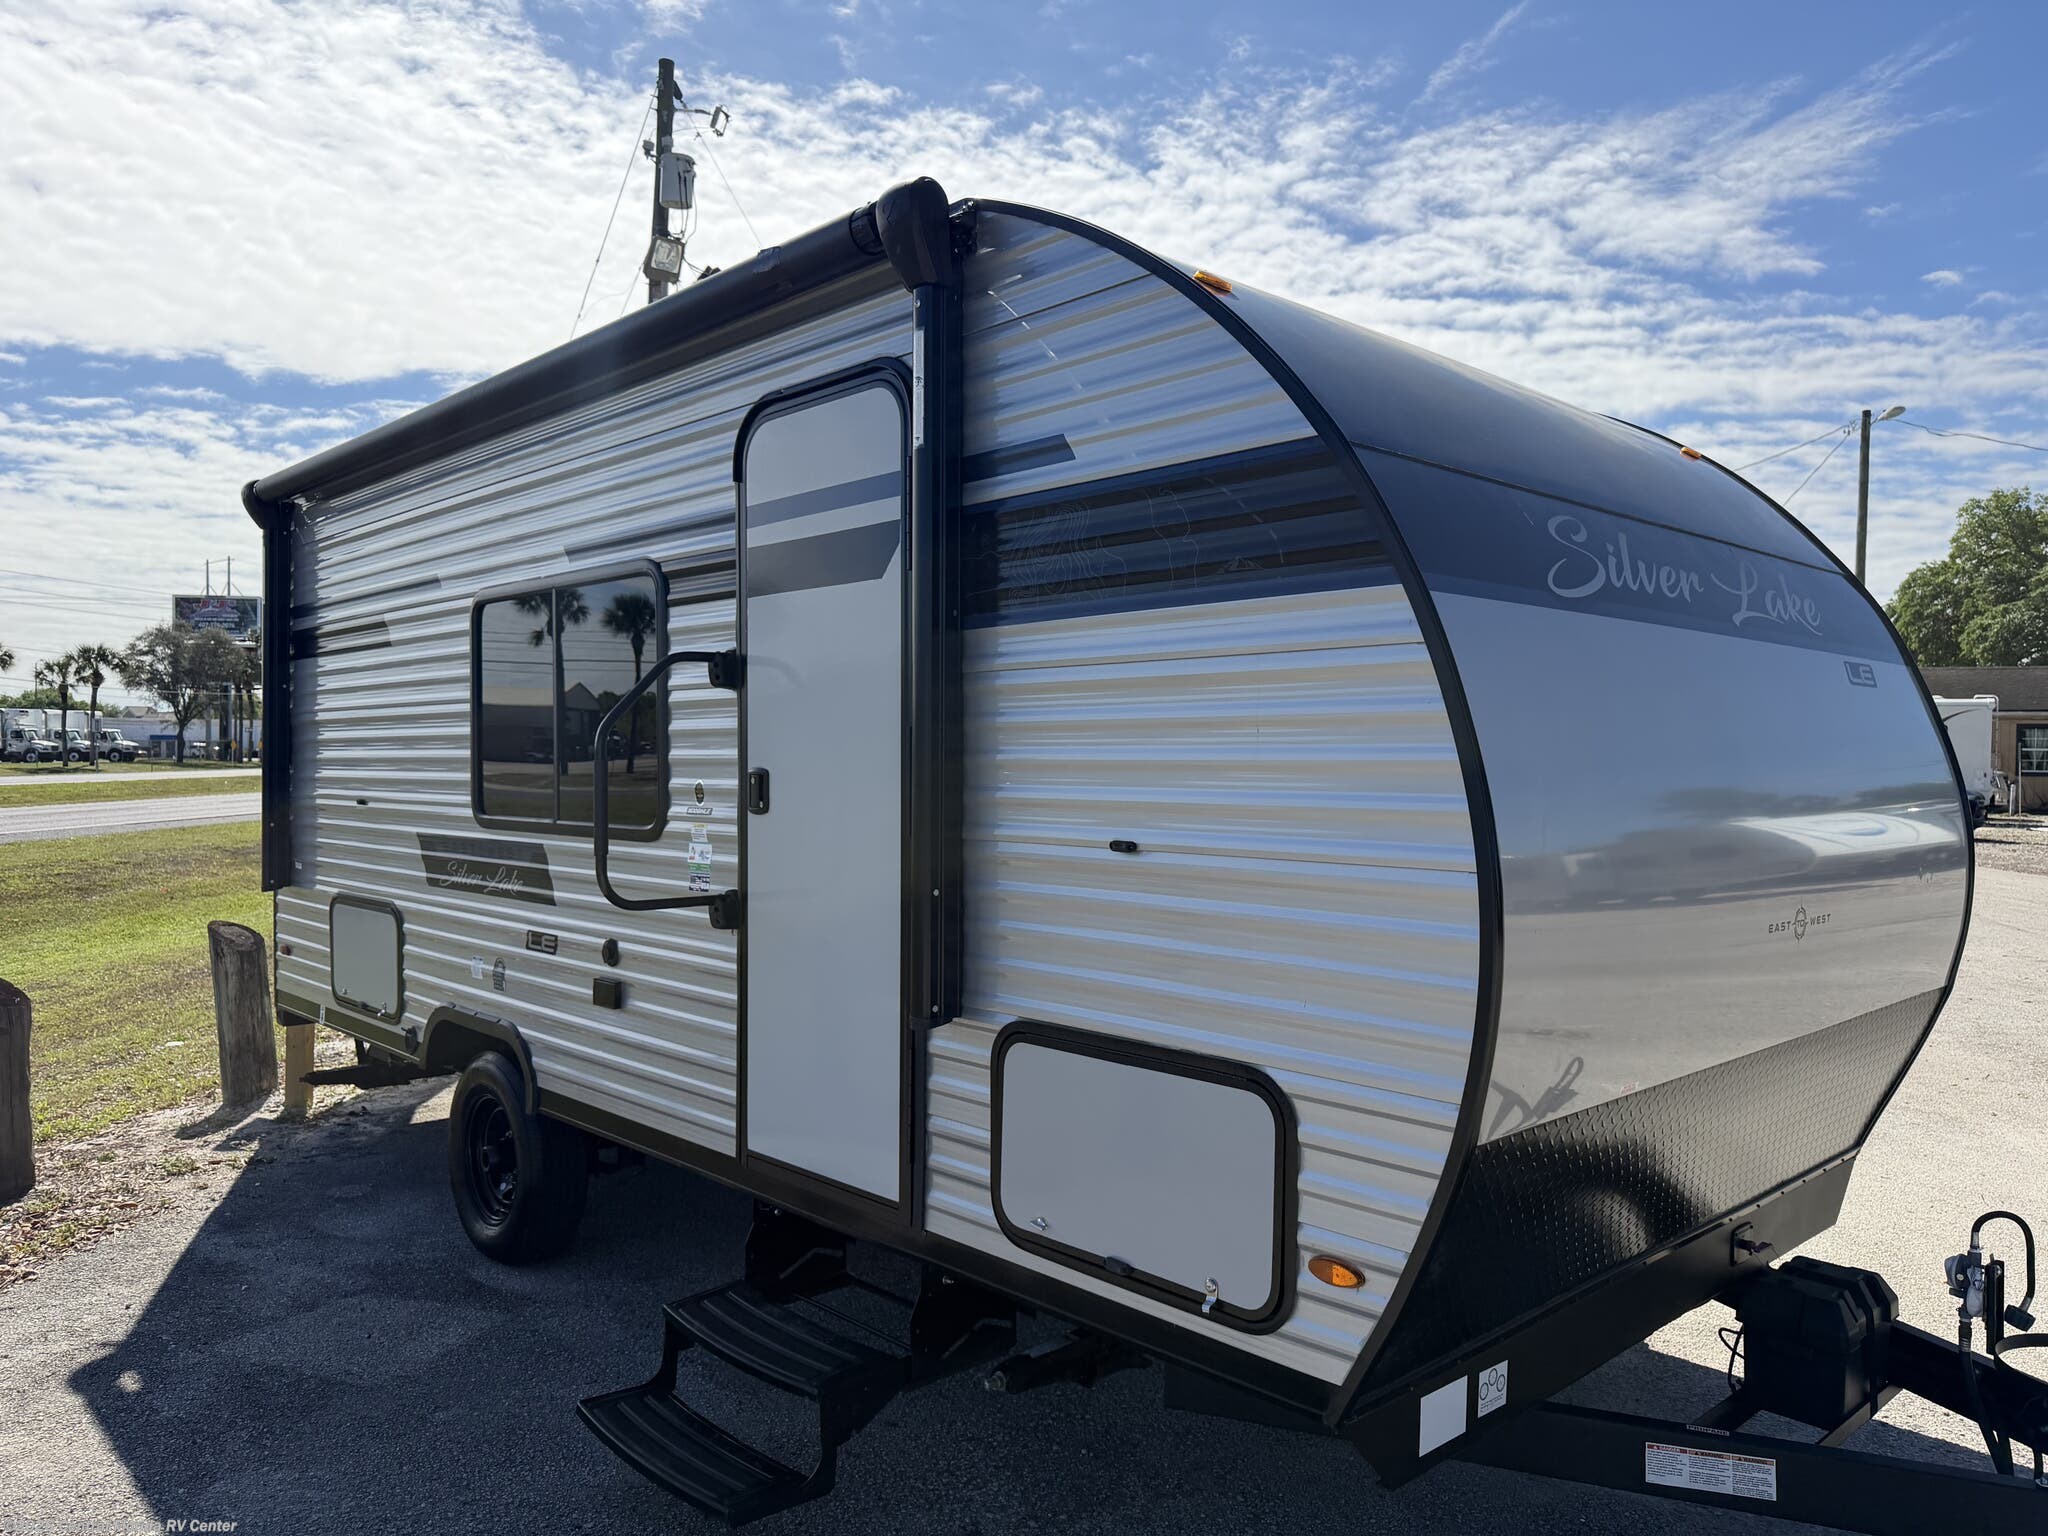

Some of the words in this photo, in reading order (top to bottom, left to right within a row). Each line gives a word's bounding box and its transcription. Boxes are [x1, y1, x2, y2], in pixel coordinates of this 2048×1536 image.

[1547, 515, 1703, 603] Silver
[1710, 560, 1823, 636] Lake
[440, 861, 482, 887] Silver
[483, 866, 525, 896] Lake
[1768, 921, 1791, 934] EAST
[1797, 920, 1805, 928] TO
[1810, 914, 1831, 926] WEST
